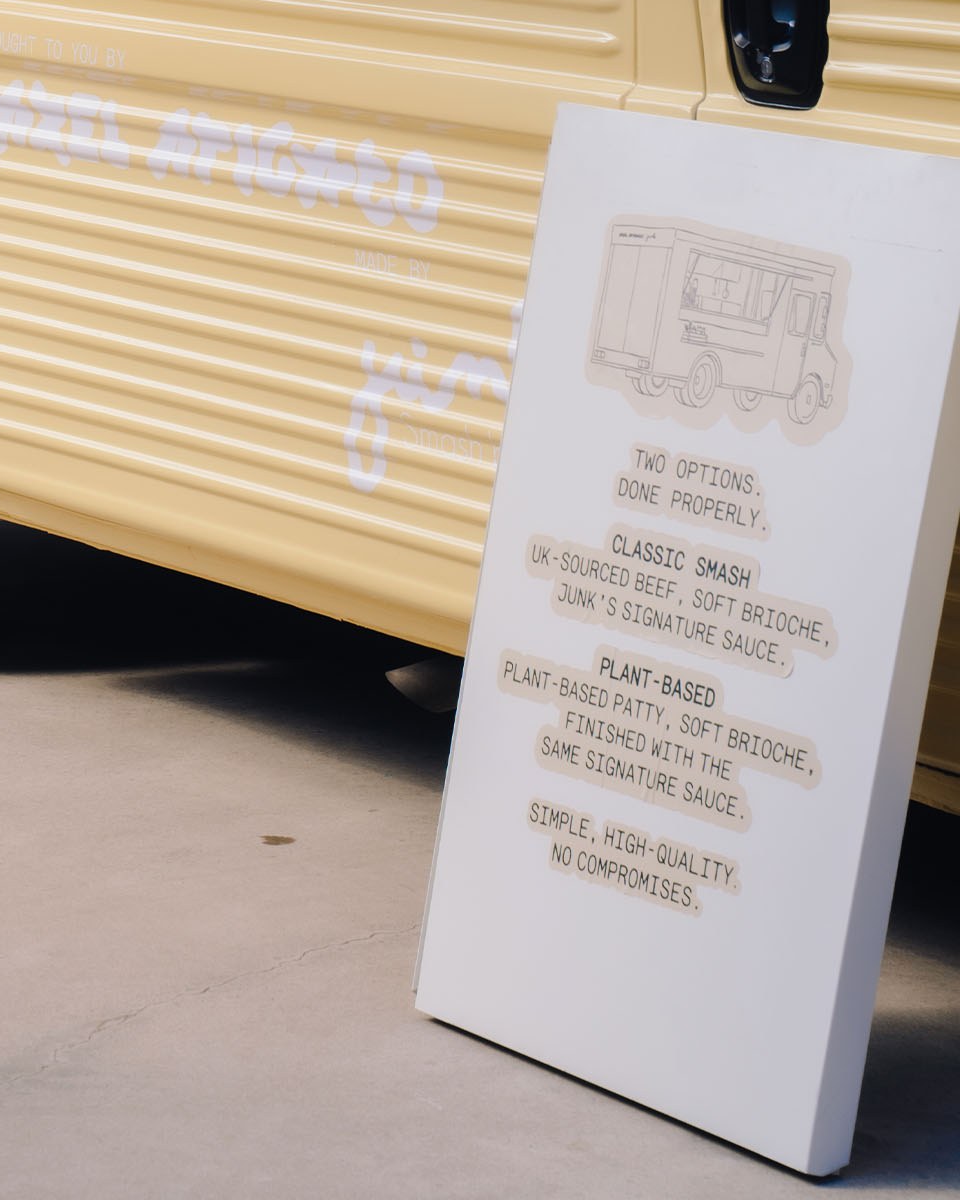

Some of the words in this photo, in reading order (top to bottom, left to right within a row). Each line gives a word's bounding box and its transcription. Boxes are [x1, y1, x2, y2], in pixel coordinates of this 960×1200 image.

[46, 37, 64, 60] TO
[71, 41, 99, 65] YOU
[106, 47, 127, 69] BY
[353, 248, 397, 275] MADE
[408, 257, 431, 282] BY
[618, 477, 661, 505] DONE
[670, 490, 766, 531] PROPERLY.
[635, 449, 666, 474] TWO
[676, 459, 761, 497] OPTIONS.
[532, 544, 630, 587] UK-SOURCED
[634, 572, 683, 606] BEEF,
[692, 588, 737, 617] SOFT
[741, 602, 830, 647] BRIOCHE,
[612, 534, 685, 571] CLASSIC
[695, 556, 751, 589] SMASH
[558, 583, 617, 617] JUNK'S
[622, 601, 718, 646] SIGNATURE
[722, 630, 785, 666] SAUCE.
[599, 657, 716, 708] PLANT-BASED
[504, 661, 608, 709] PLANT-BASED
[613, 693, 670, 730] PATTY,
[680, 713, 724, 743] SOFT
[728, 728, 814, 777] BRIOCHE,
[565, 711, 646, 753] FINISHED
[651, 738, 695, 769] WITH
[700, 752, 733, 781] THE
[541, 736, 581, 766] SAME
[585, 751, 679, 797] SIGNATURE
[682, 781, 745, 820] SAUCE.
[529, 802, 595, 844] SIMPLE,
[604, 826, 738, 889] HIGH-QUALITY.
[551, 842, 572, 866] NO
[577, 850, 699, 910] COMPROMISES.
